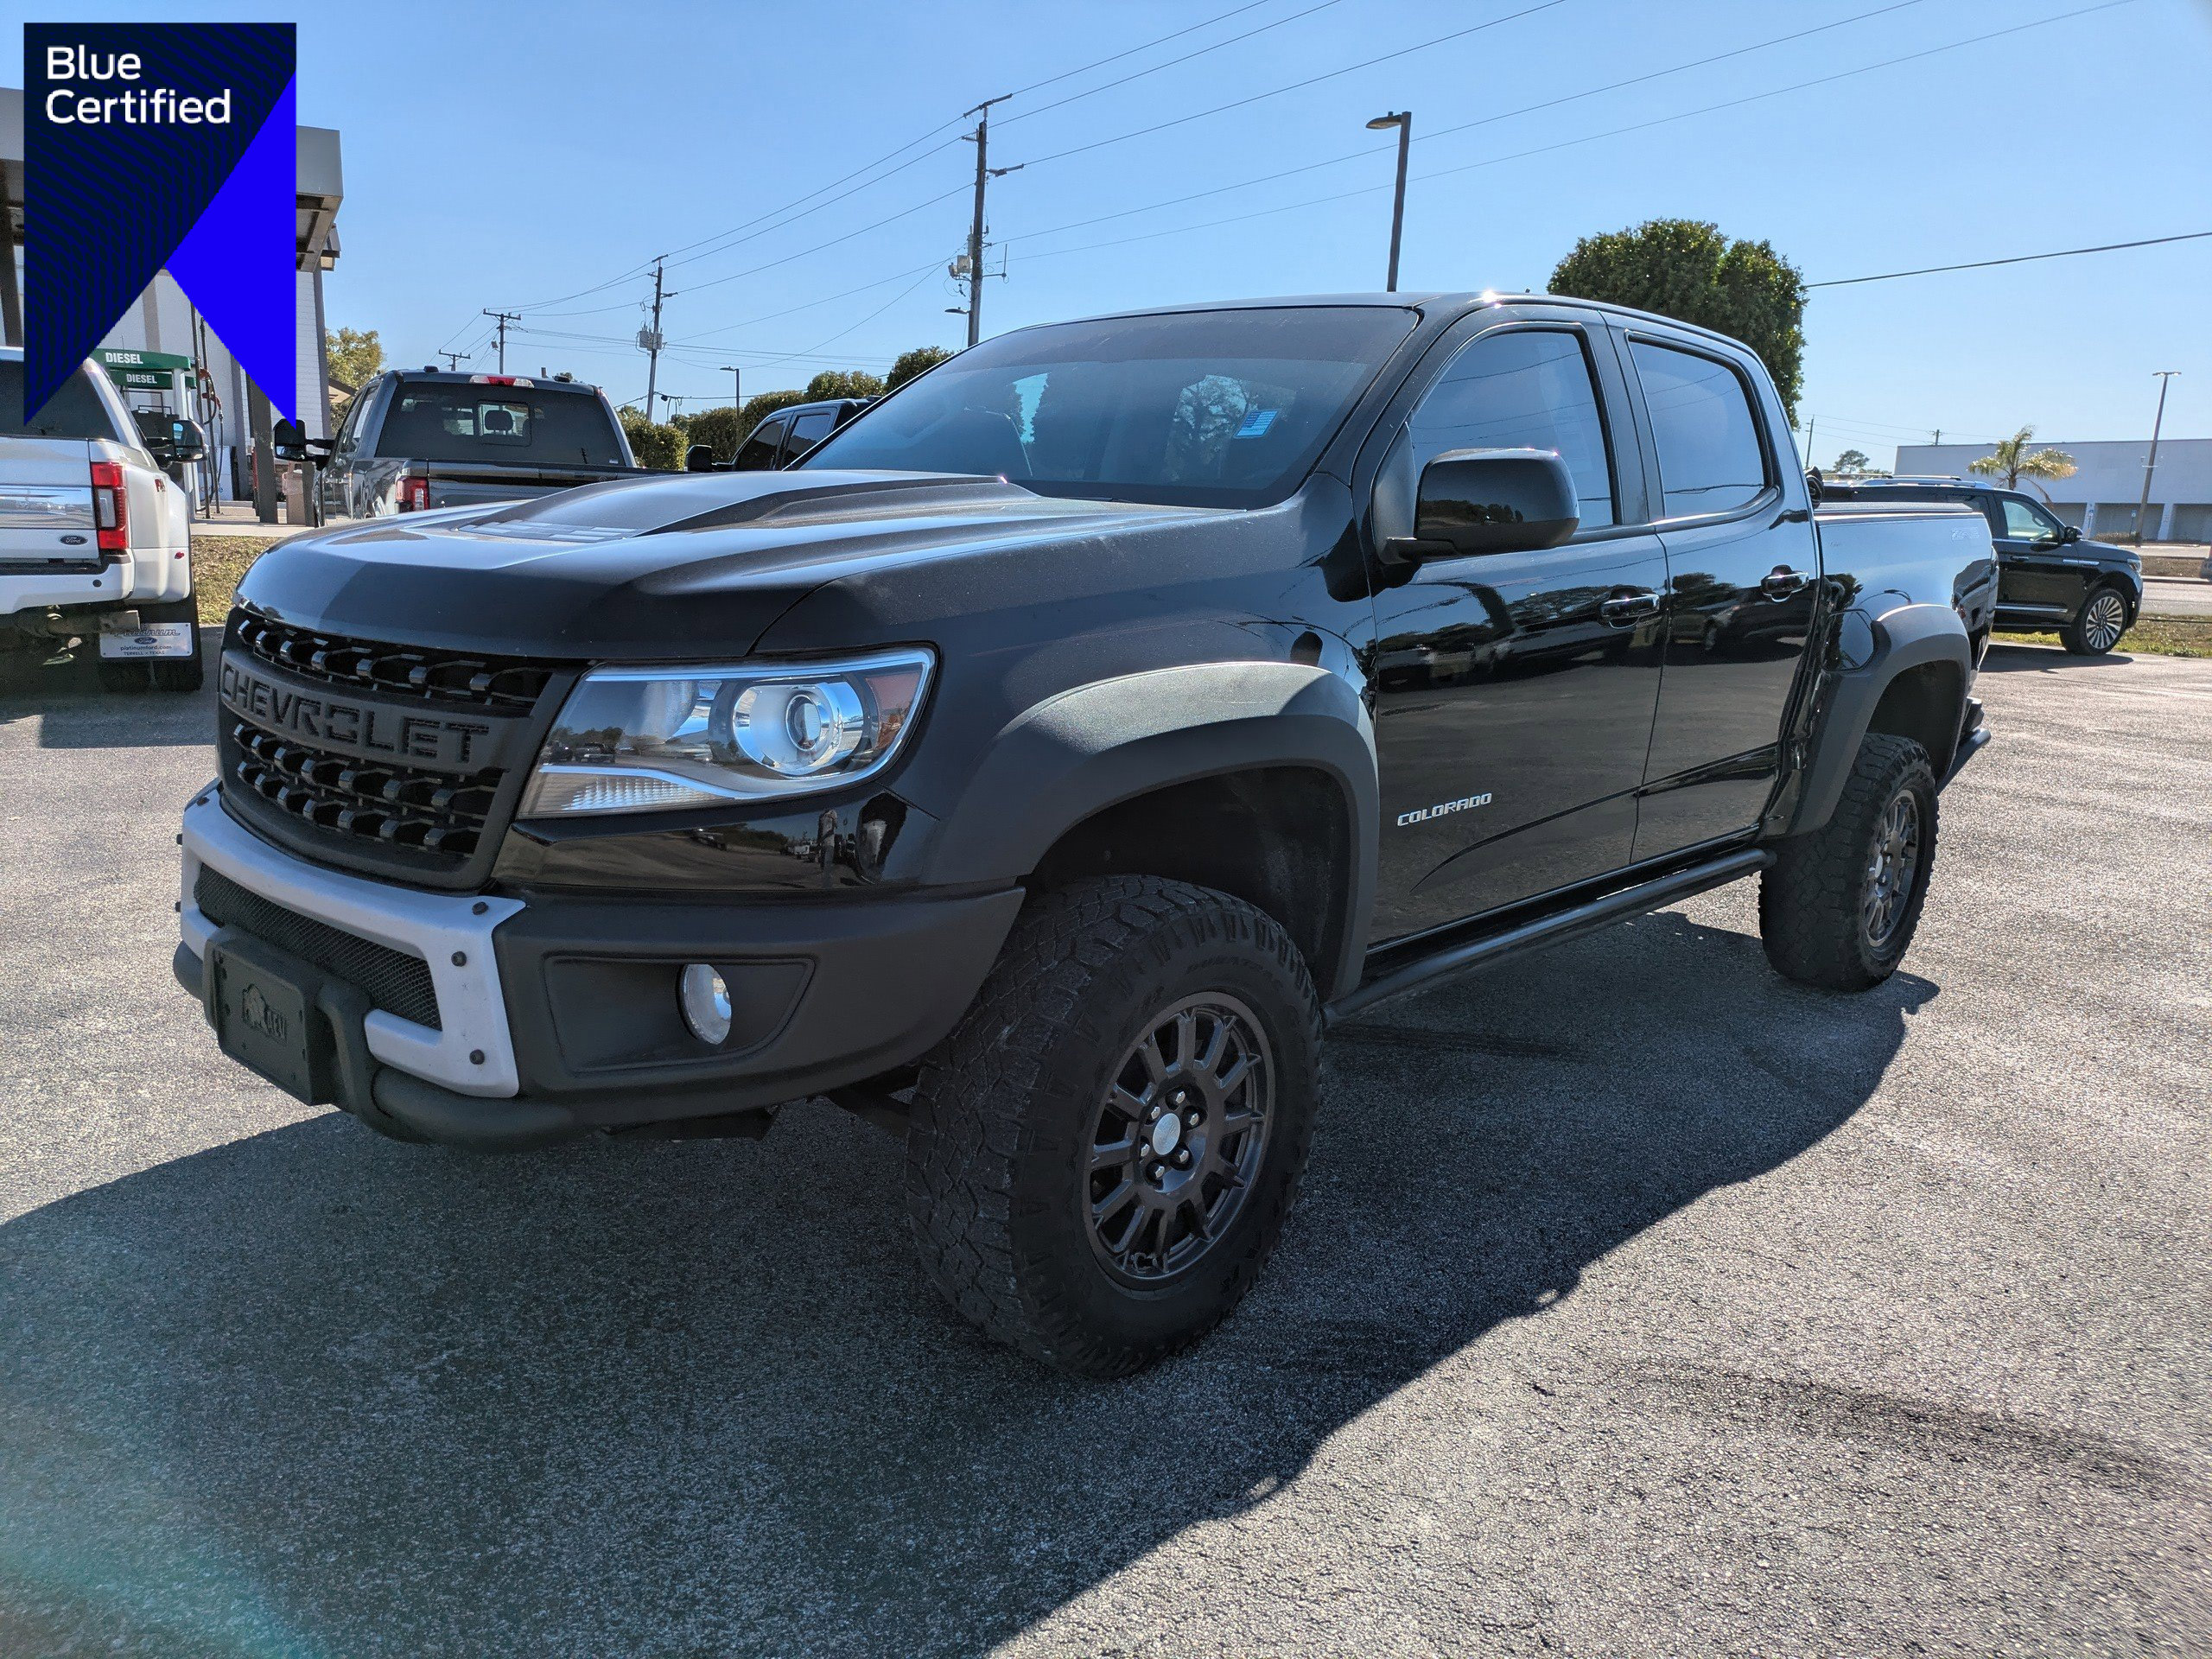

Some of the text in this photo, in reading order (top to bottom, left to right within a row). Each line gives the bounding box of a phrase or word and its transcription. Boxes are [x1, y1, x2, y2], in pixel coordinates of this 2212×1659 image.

[105, 352, 143, 364] DIESEL
[126, 373, 157, 384] DIESEL
[221, 663, 490, 764] CHEVROLET
[1397, 792, 1492, 827] COLORADO
